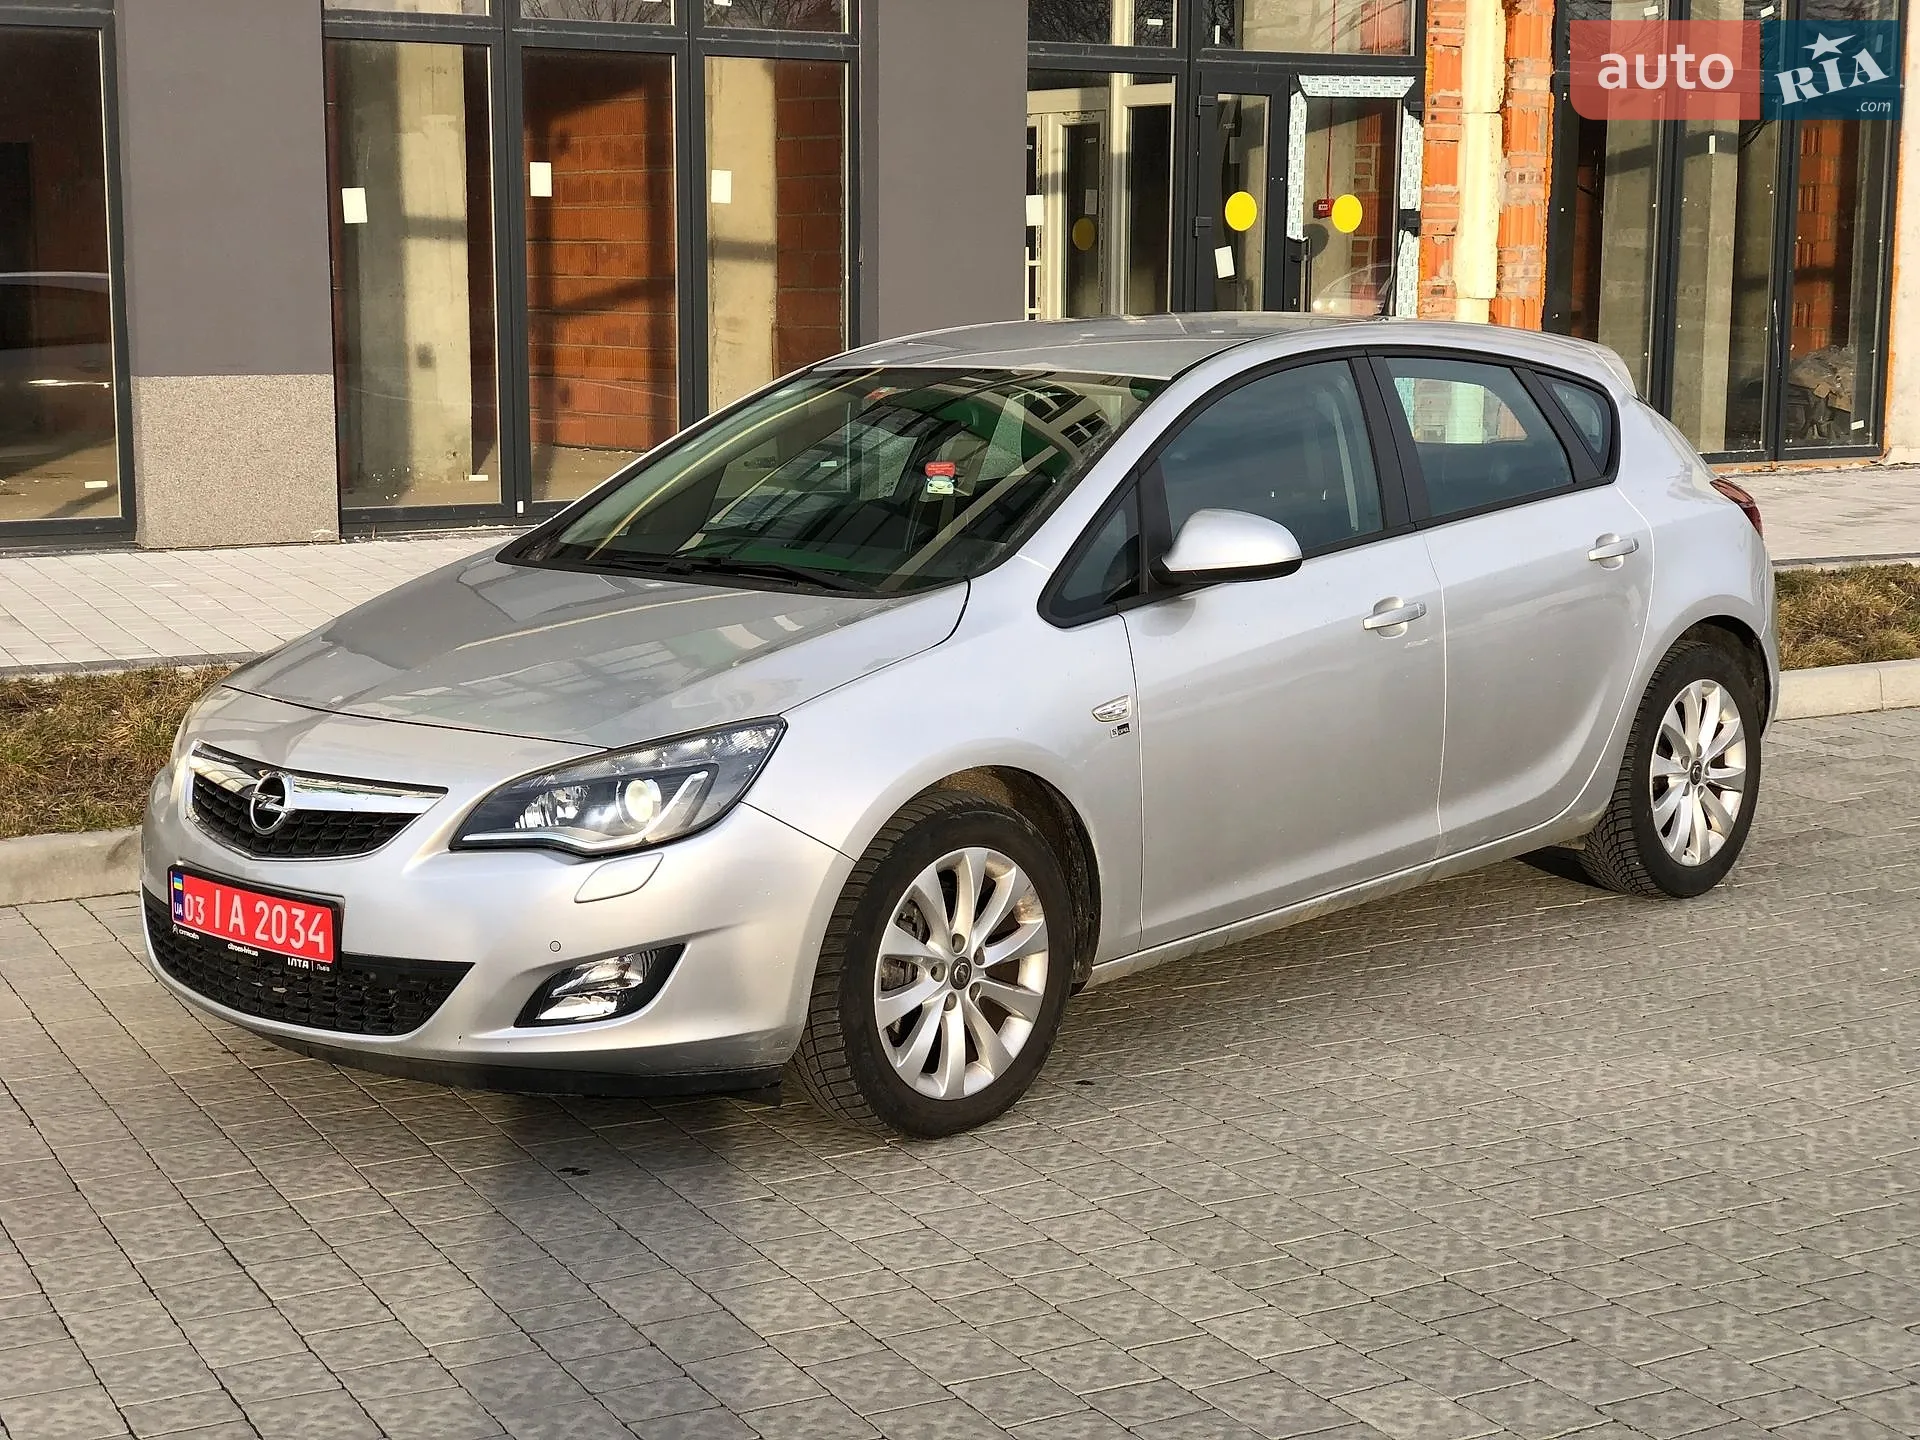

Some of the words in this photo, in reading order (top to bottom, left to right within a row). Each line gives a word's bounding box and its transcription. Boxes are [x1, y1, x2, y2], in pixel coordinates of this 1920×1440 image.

[175, 902, 183, 916] UA
[185, 893, 205, 926] 03
[254, 900, 325, 953] 2034
